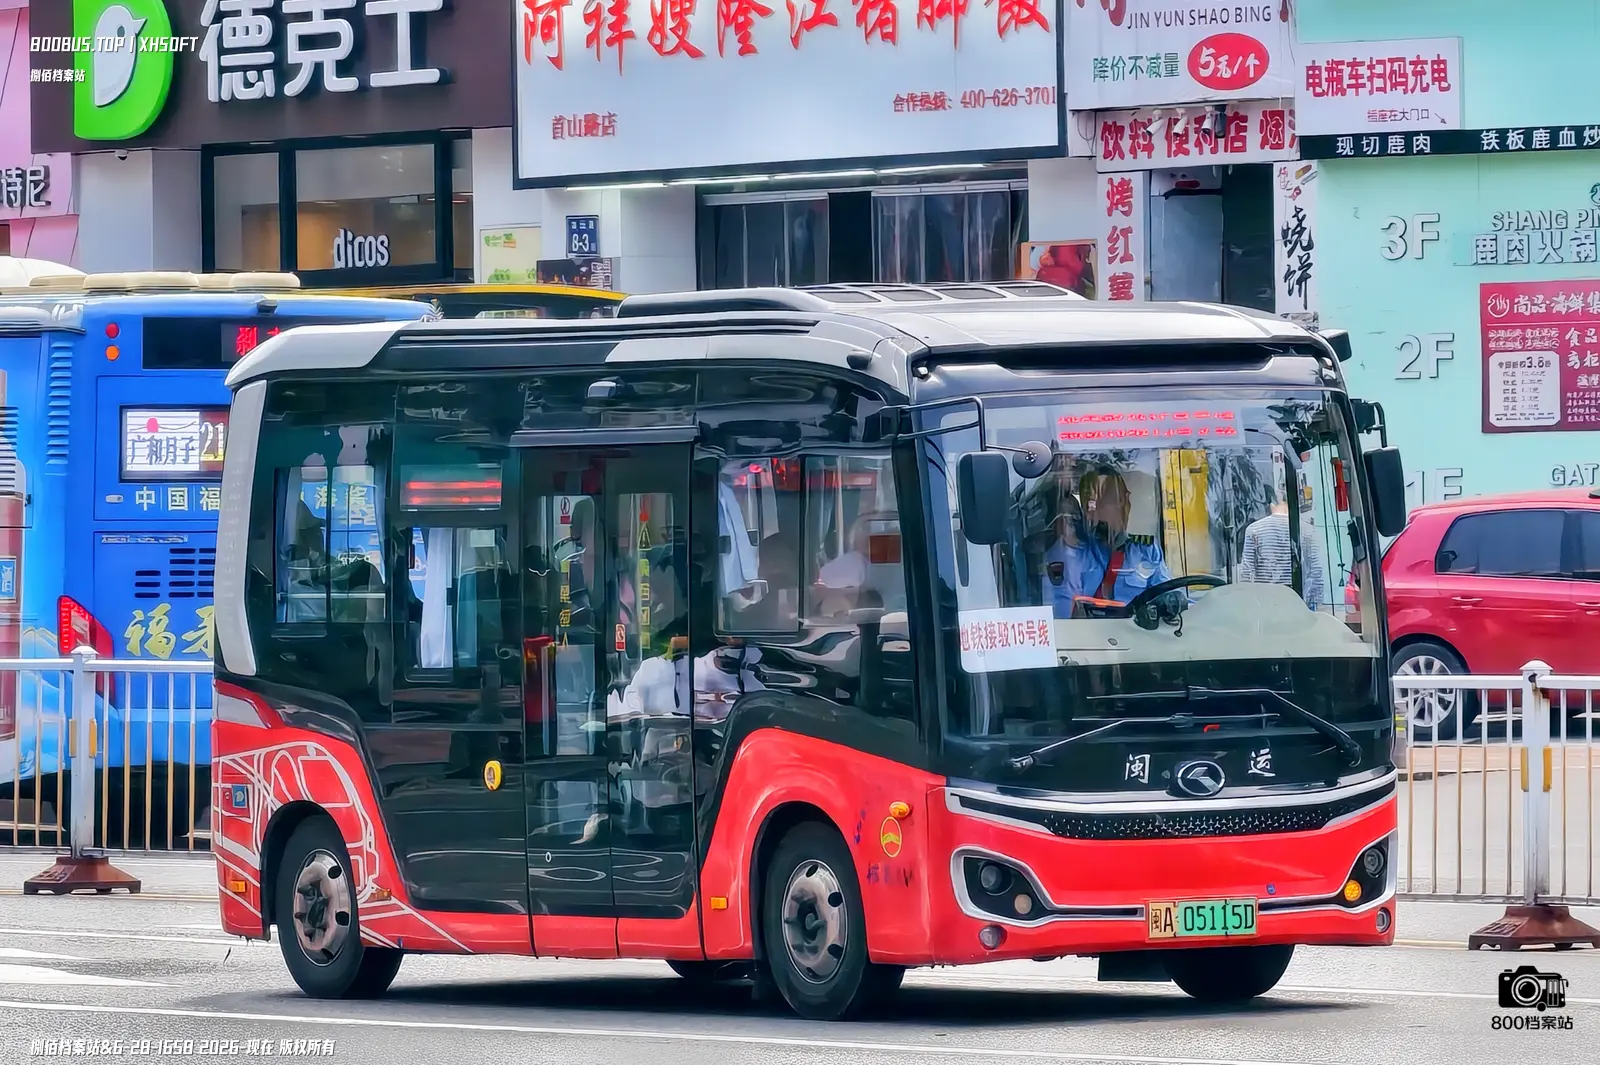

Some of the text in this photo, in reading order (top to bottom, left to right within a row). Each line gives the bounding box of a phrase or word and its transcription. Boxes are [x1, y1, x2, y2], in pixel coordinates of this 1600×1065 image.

[1127, 12, 1150, 30] JIN
[1154, 9, 1185, 28] YUN
[1189, 8, 1230, 26] SHAO
[1235, 5, 1273, 23] BING
[1093, 52, 1180, 82] 降价不减量
[1305, 54, 1451, 98] 电瓶车扫码充电
[1336, 126, 1600, 156] 现切鹿肉 铁板鹿血炒
[1380, 212, 1440, 260] 3F
[1492, 209, 1568, 232] SHANG
[333, 228, 390, 268] dicos
[1473, 230, 1598, 265] 鹿肉火锅
[1395, 332, 1455, 380] 2F
[1124, 748, 1276, 784] 闽 运
[1183, 903, 1255, 932] 05115D
